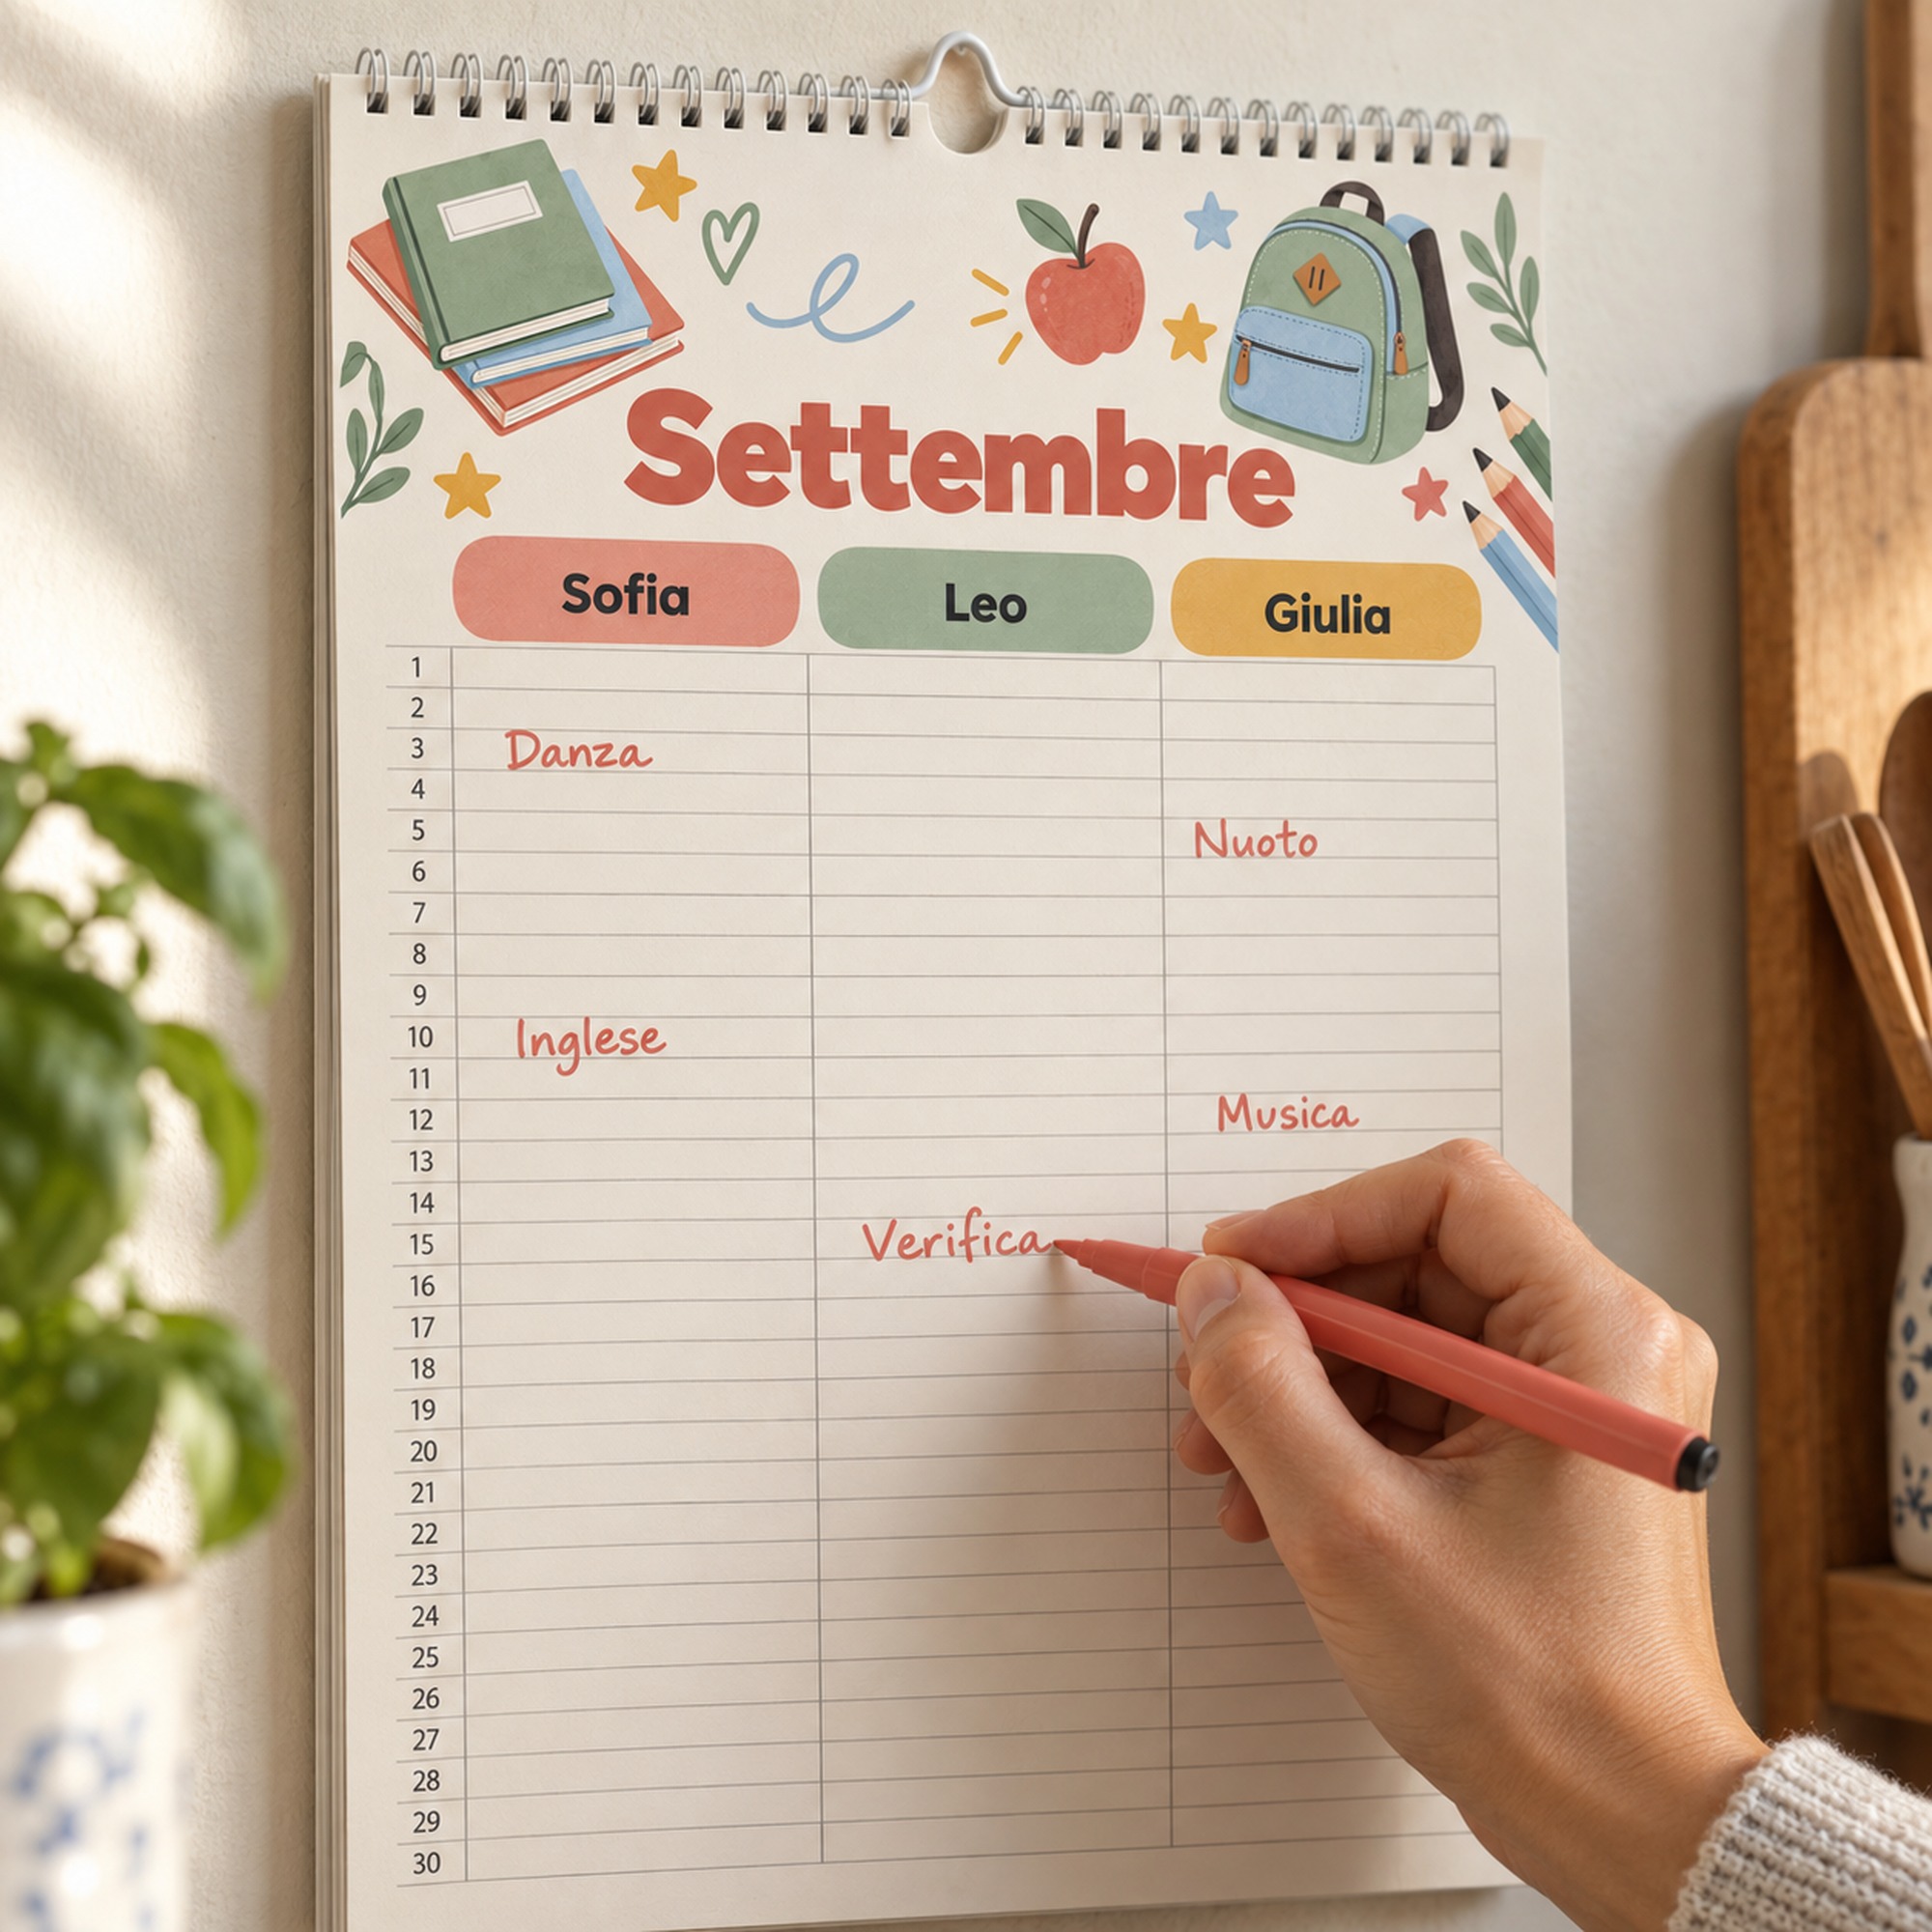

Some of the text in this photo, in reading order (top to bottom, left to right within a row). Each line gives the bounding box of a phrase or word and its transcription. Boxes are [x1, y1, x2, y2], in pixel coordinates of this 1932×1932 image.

[623, 387, 1295, 528] Settembre
[561, 572, 689, 616] Sofia
[945, 582, 1028, 624] Leo
[1264, 592, 1390, 635] Giulia
[411, 656, 422, 678] 1
[411, 696, 424, 719] 2
[412, 737, 424, 759] 3
[504, 729, 654, 771] Danza
[411, 778, 425, 800] 4
[412, 819, 425, 841] 5
[1194, 818, 1318, 859] Nuoto
[412, 860, 426, 882] 6
[412, 901, 426, 923] 7
[412, 942, 427, 965] 8
[412, 983, 427, 1007] 9
[408, 1025, 434, 1048] 10
[515, 1016, 668, 1077] Inglese
[410, 1067, 429, 1090] 11
[410, 1108, 433, 1130] 12
[1218, 1093, 1360, 1132] Musica
[410, 1150, 434, 1172] 13
[410, 1192, 435, 1213] 14
[410, 1234, 434, 1255] 15
[862, 1205, 1055, 1264] Verifica
[411, 1274, 436, 1297] 16
[411, 1316, 435, 1338] 17
[411, 1357, 436, 1379] 18
[411, 1398, 436, 1421] 19
[411, 1439, 438, 1463] 20
[411, 1481, 434, 1504] 21
[411, 1522, 439, 1546] 22
[412, 1564, 439, 1586] 23
[412, 1605, 440, 1628] 24
[412, 1646, 439, 1668] 25
[412, 1687, 440, 1710] 26
[412, 1728, 440, 1751] 27
[412, 1769, 440, 1792] 28
[413, 1810, 440, 1833] 29
[413, 1851, 440, 1875] 30
